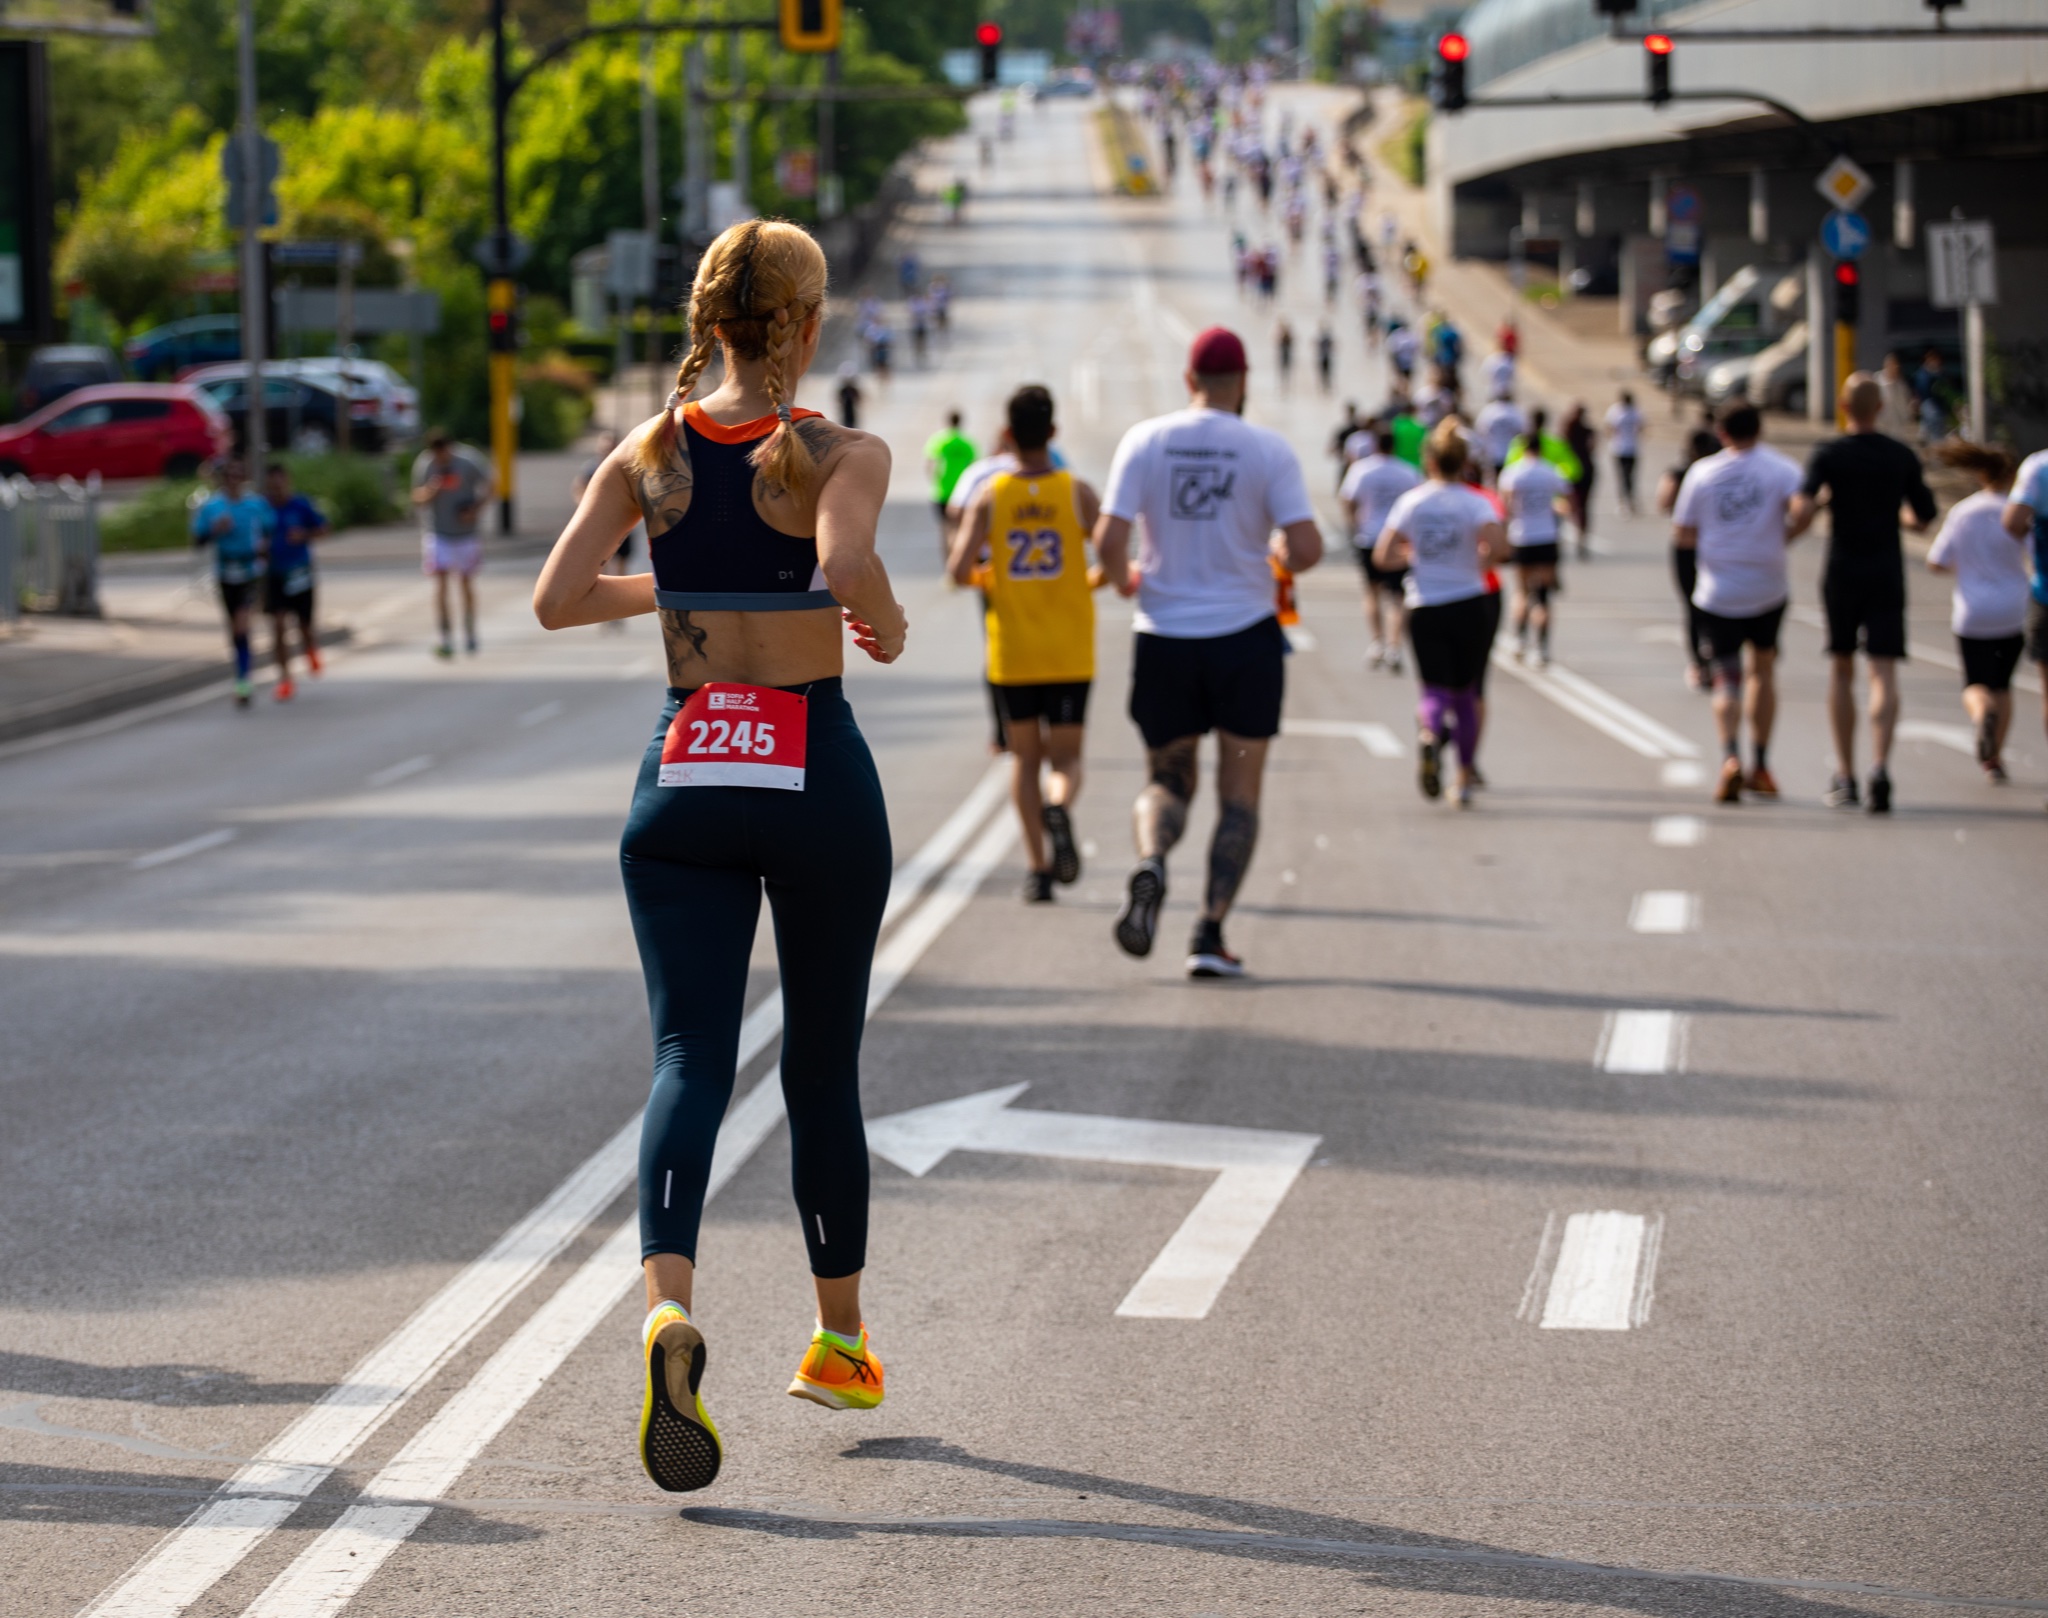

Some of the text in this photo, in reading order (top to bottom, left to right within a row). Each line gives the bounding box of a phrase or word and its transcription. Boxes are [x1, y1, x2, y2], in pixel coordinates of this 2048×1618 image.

[1006, 528, 1063, 580] 23
[778, 570, 794, 580] D1
[688, 719, 775, 756] 2245
[665, 769, 694, 784] 21K
